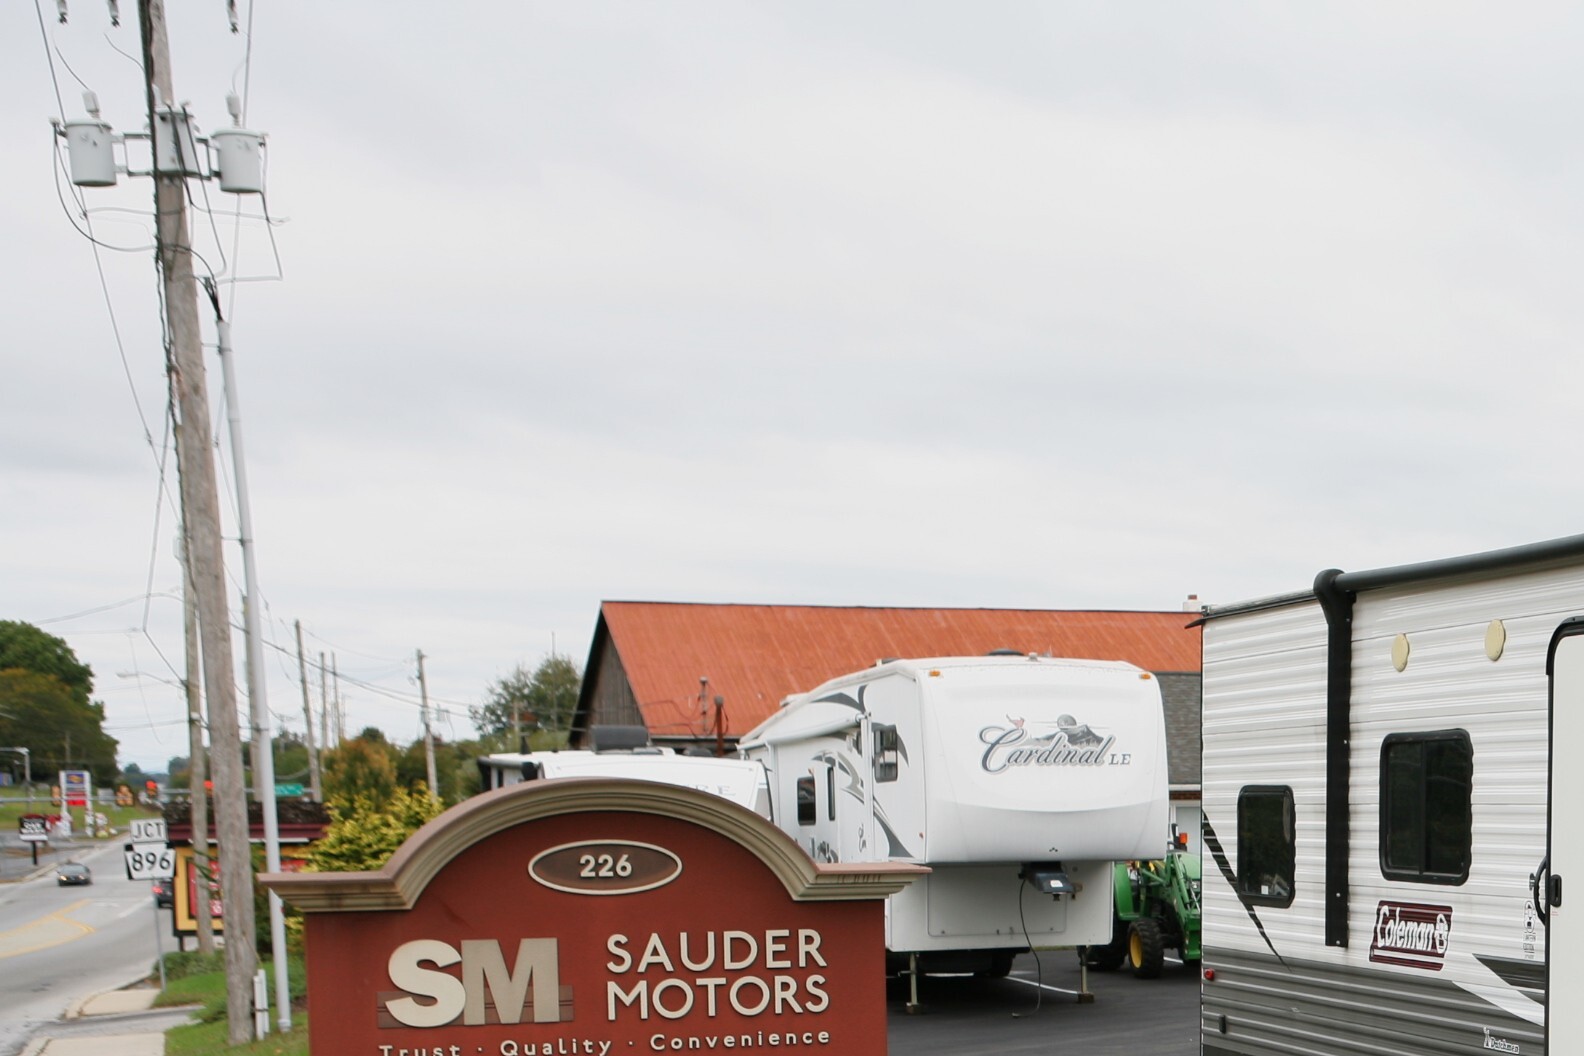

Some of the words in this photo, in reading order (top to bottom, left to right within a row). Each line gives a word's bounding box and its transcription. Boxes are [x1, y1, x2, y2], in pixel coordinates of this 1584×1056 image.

[979, 726, 1115, 774] Cardinal
[1108, 753, 1132, 766] LE
[133, 822, 164, 839] JCT
[132, 852, 171, 872] 896
[579, 854, 632, 877] 226
[606, 928, 828, 974] SAUDER
[1377, 905, 1435, 952] Coleman
[385, 937, 560, 1028] SM
[606, 974, 829, 1021] MOTORS
[650, 1031, 830, 1051] Convenience
